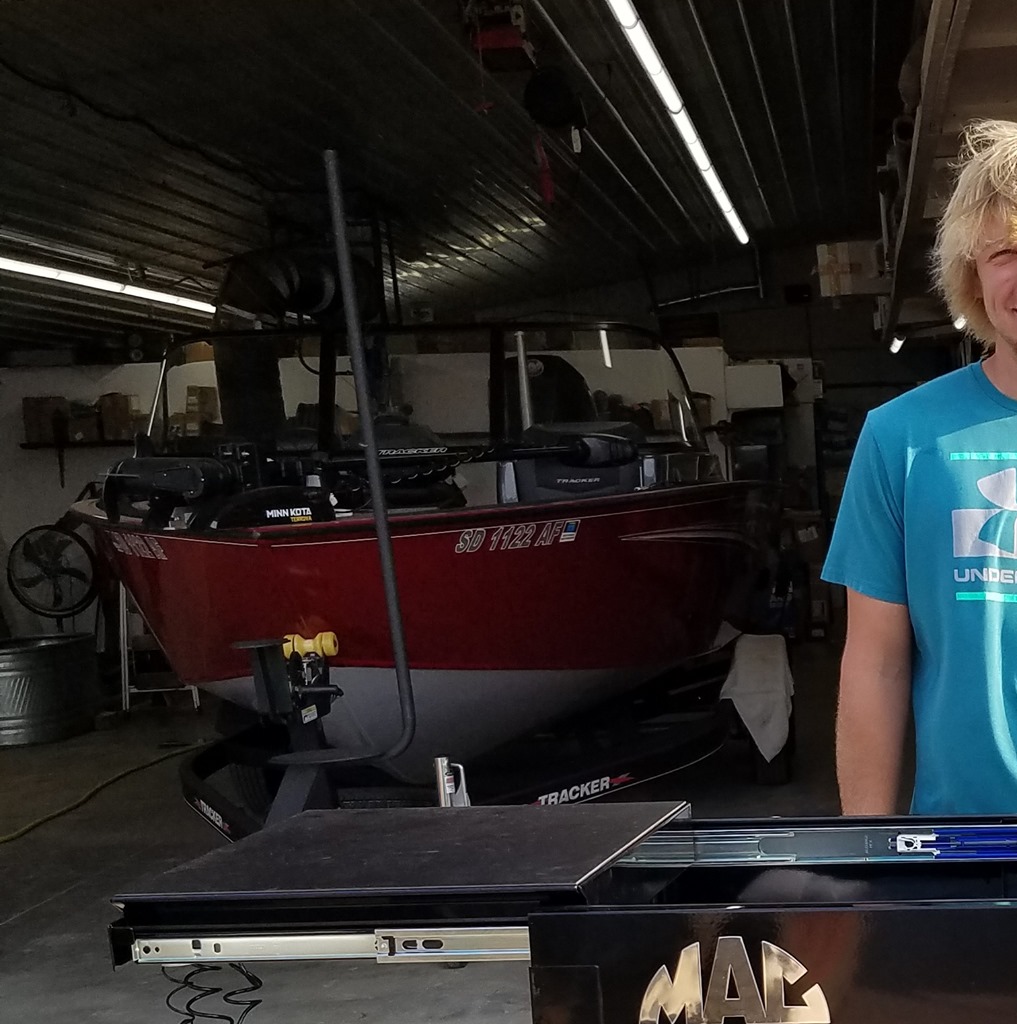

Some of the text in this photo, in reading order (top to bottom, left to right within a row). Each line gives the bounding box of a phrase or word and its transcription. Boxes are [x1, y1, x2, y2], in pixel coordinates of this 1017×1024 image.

[265, 506, 312, 518] MINN KOTA
[455, 521, 563, 553] SD 1122 AF
[538, 776, 611, 806] TRACKER
